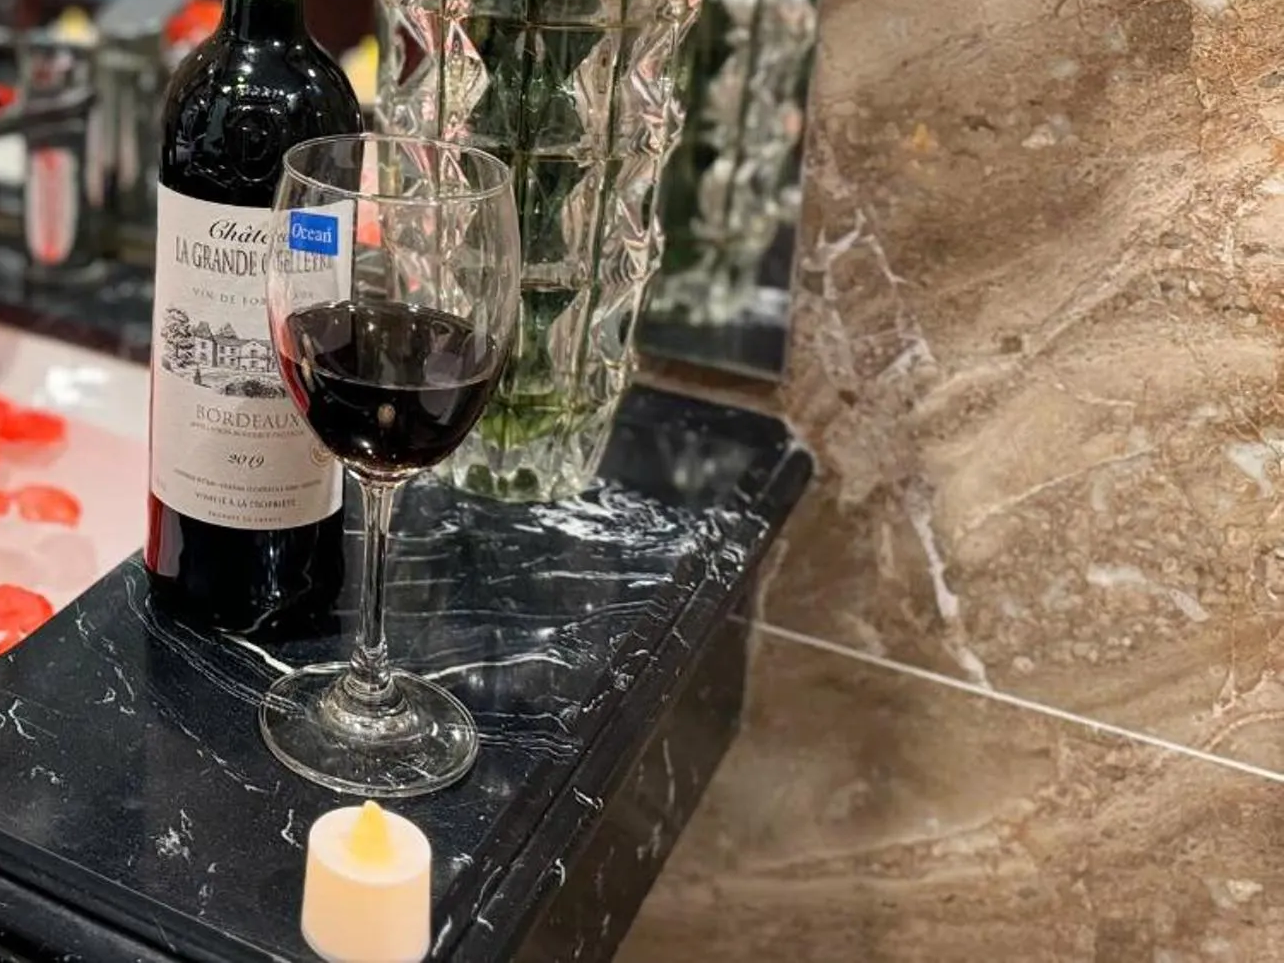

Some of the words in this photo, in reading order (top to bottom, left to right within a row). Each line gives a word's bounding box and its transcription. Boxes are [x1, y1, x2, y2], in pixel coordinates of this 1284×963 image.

[175, 236, 190, 266] LA
[192, 241, 257, 278] GRANDE
[192, 287, 215, 301] VIN
[220, 293, 236, 306] DE
[196, 404, 301, 430] BORDEAUX
[227, 451, 265, 469] 2019
